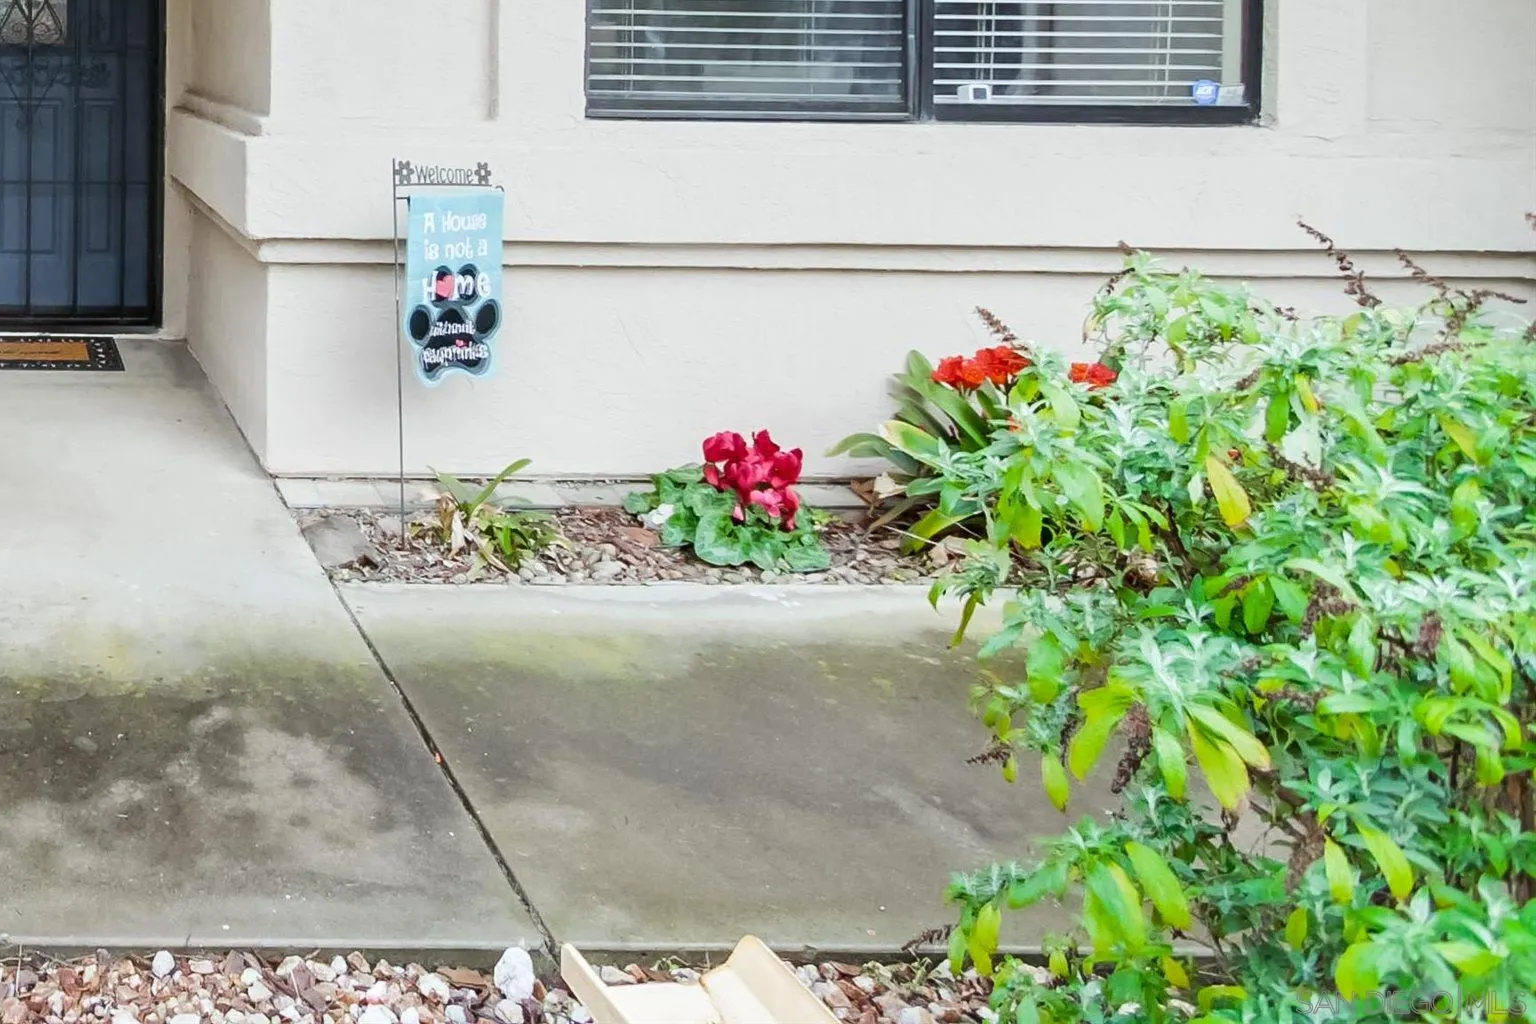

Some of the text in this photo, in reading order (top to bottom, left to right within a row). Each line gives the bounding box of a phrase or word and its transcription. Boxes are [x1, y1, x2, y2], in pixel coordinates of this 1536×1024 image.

[414, 164, 473, 184] Welcome
[423, 210, 488, 234] A House
[424, 236, 489, 261] is not a
